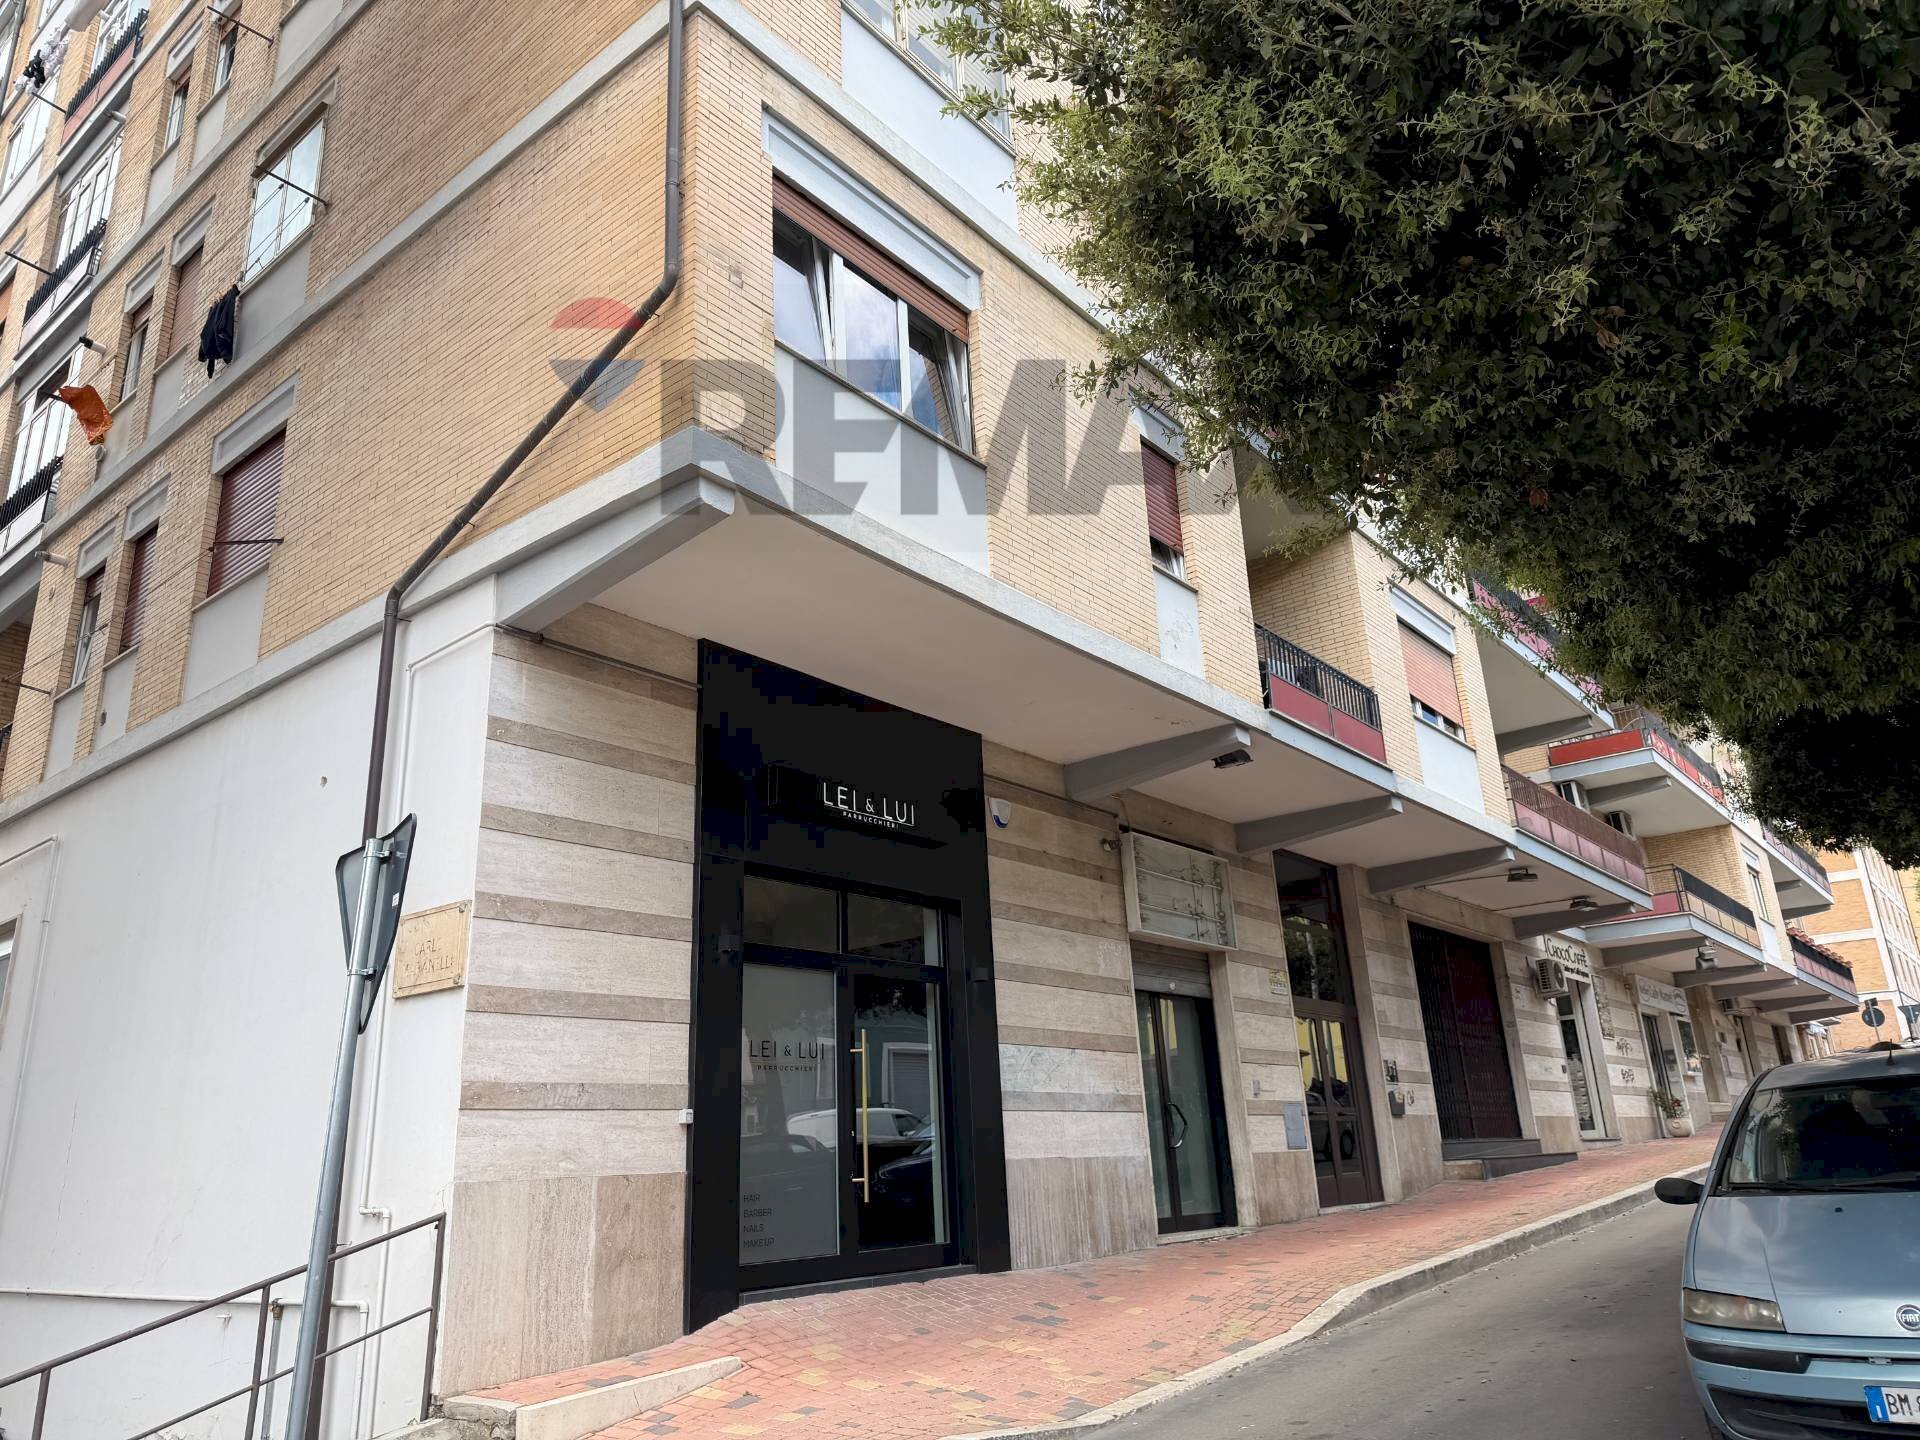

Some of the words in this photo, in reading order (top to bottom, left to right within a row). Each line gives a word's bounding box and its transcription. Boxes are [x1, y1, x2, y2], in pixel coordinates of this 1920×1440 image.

[823, 782, 856, 811] LEI
[865, 798, 875, 813] &
[884, 797, 914, 825] LUI
[843, 811, 899, 829] PARRUCCHIERI
[750, 1040, 776, 1057] LEI
[784, 1045, 792, 1057] &
[799, 1042, 824, 1059] LUI
[743, 1193, 761, 1202] HAIR
[743, 1208, 772, 1217] BARBER
[743, 1223, 764, 1232] NAILS
[1902, 1313, 1920, 1322] FIAT
[1885, 1393, 1912, 1416] BM
